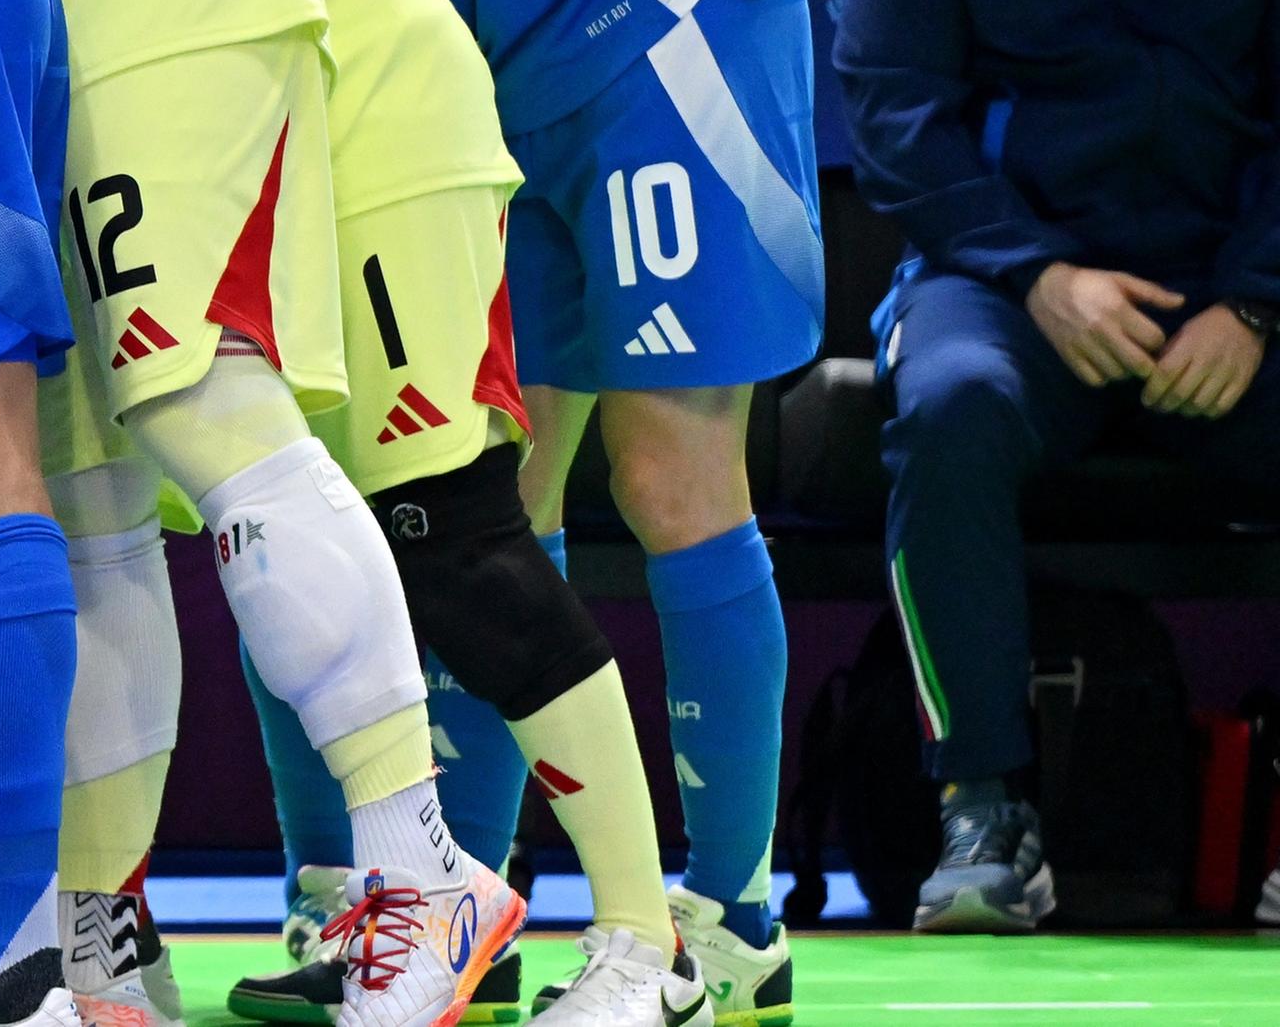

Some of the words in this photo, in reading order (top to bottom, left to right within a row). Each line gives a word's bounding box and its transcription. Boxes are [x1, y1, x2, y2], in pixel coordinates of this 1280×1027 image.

[585, 0, 632, 38] HEAT.RDY
[68, 173, 158, 304] 12
[606, 161, 700, 288] 10
[362, 253, 408, 370] 1
